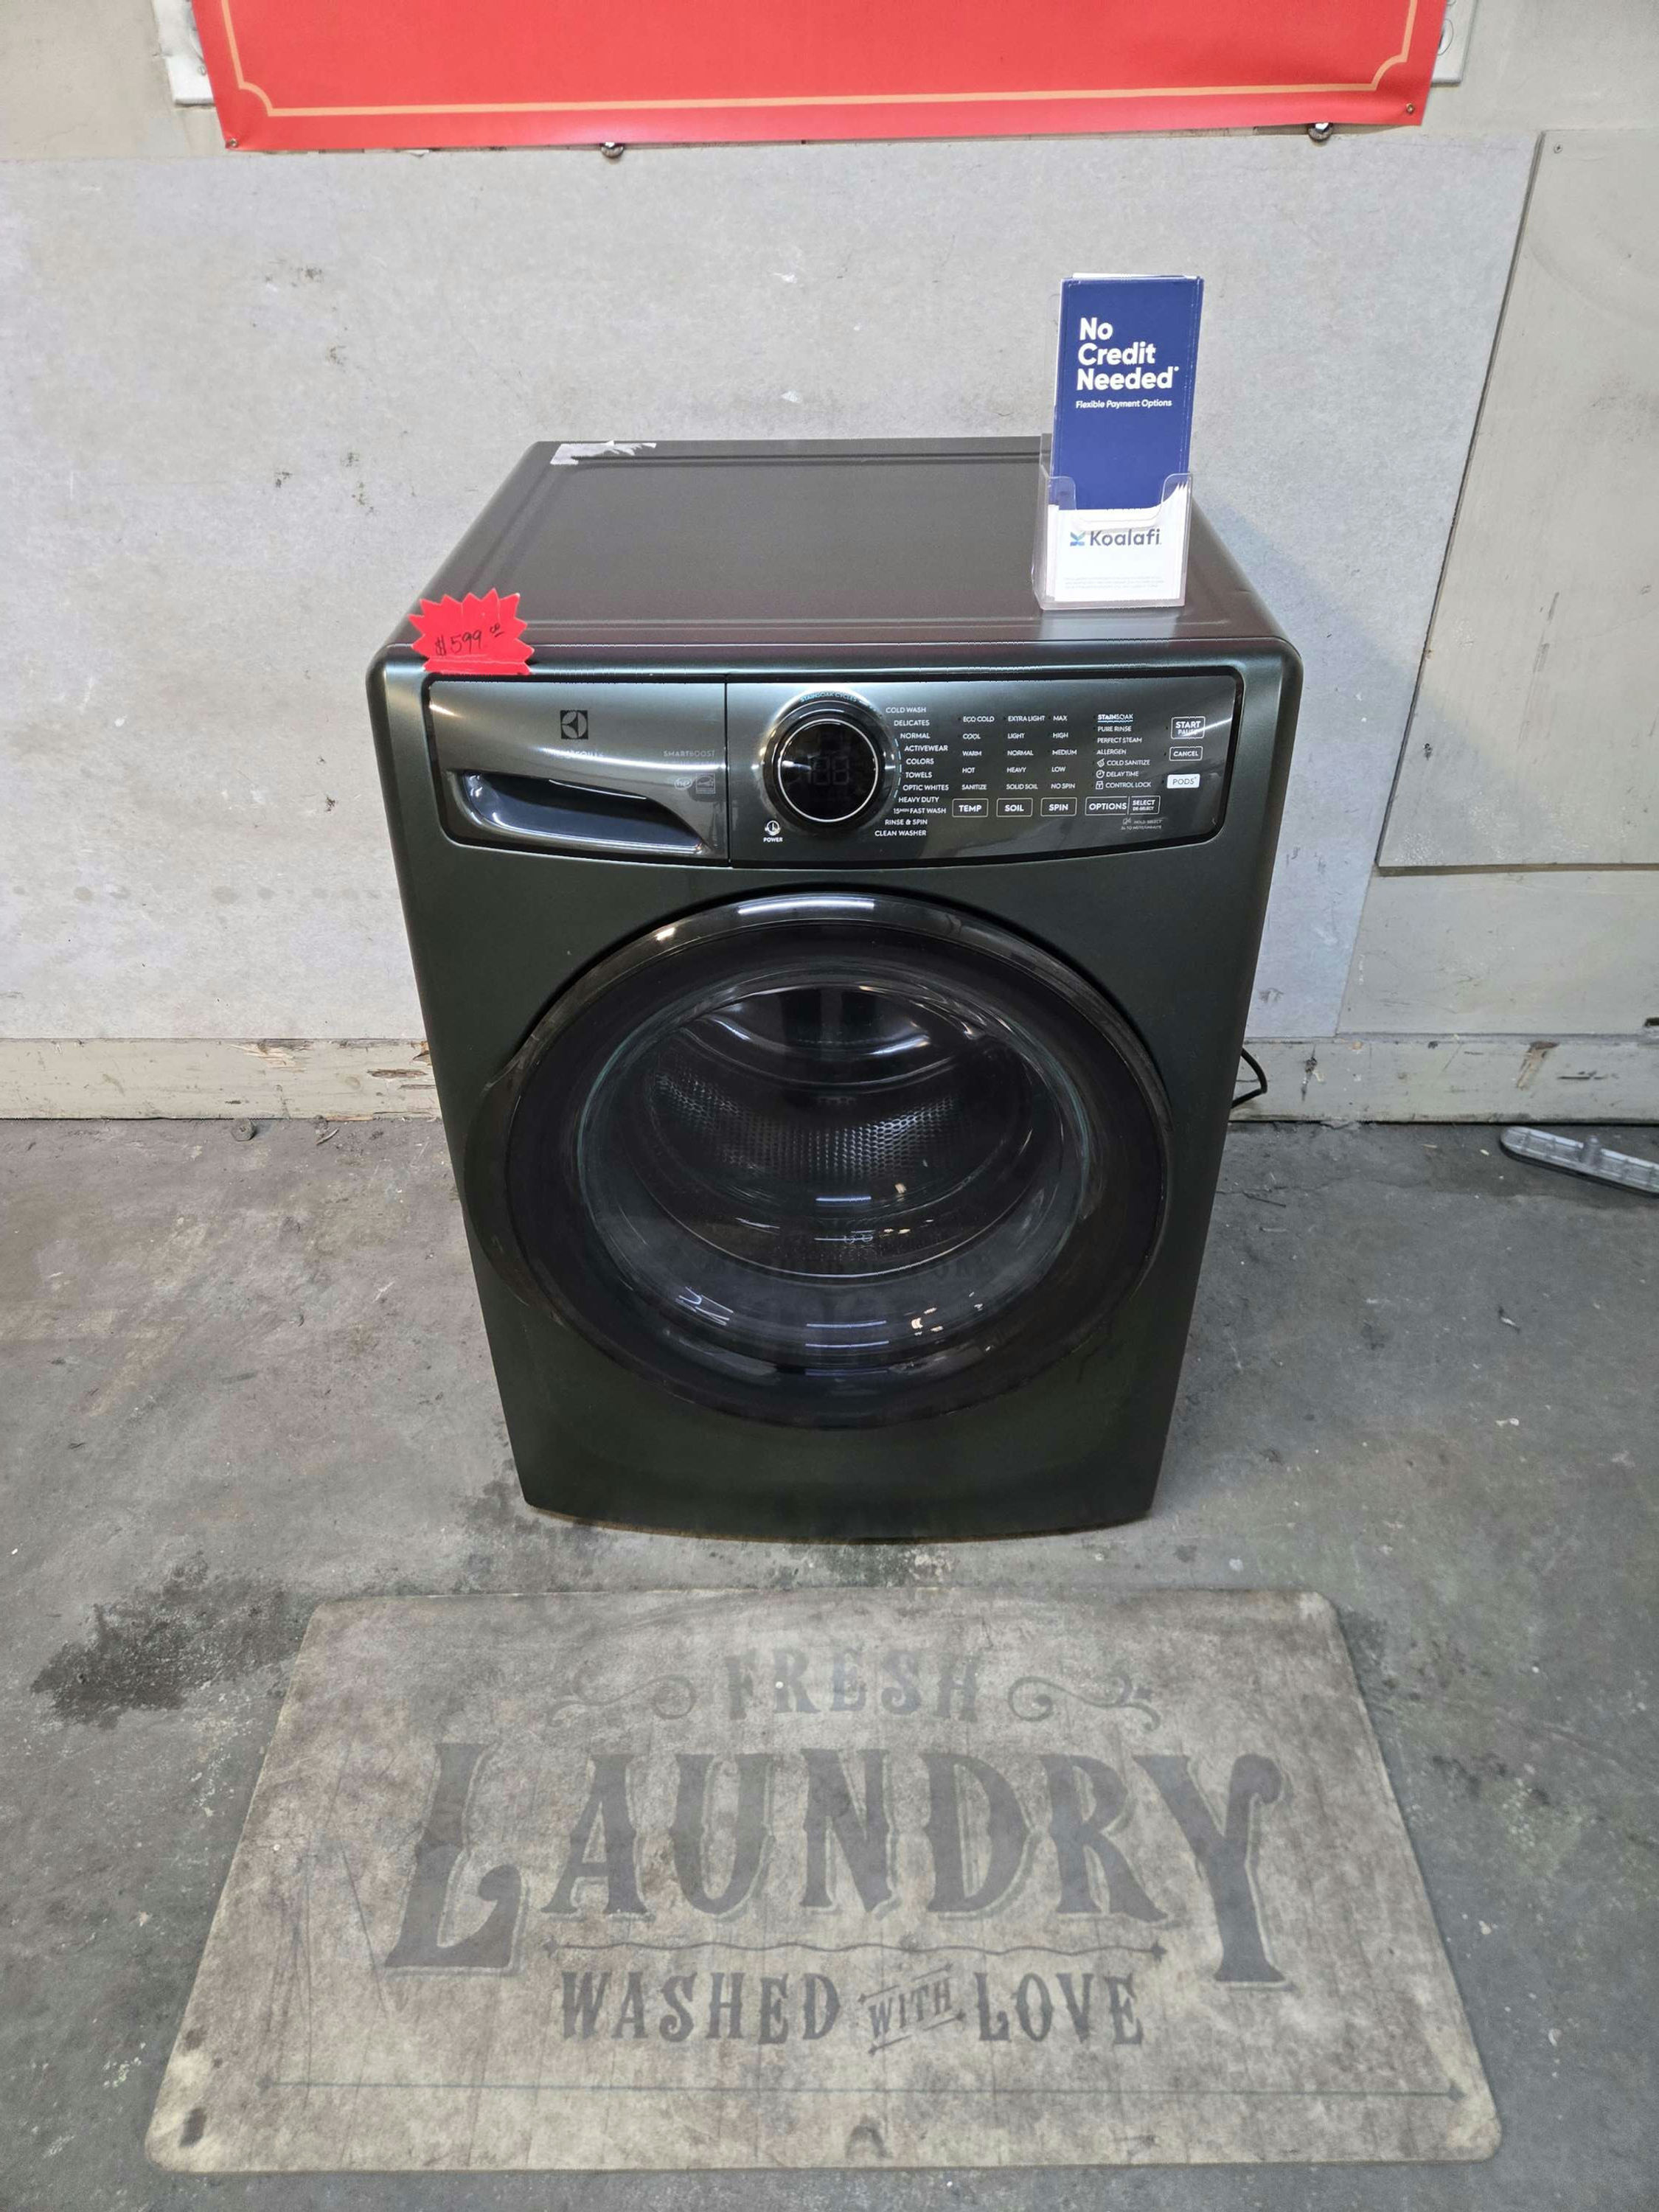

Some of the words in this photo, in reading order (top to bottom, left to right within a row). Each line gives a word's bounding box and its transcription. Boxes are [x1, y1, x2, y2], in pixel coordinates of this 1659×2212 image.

[1079, 317, 1113, 341] No
[1078, 341, 1156, 366] Credit
[1076, 400, 1105, 408] Flexible
[1107, 400, 1141, 410] Payment
[1142, 398, 1172, 408] Options
[1090, 528, 1161, 546] Koalafi
[959, 804, 982, 813] TEMP
[1089, 802, 1127, 810] OPTIONS
[723, 1647, 982, 1722] FRESH
[385, 1742, 1289, 1988] LAUNDRY
[560, 1970, 841, 2045] WASHED
[867, 1976, 953, 2039] WITH
[974, 1972, 1144, 2045] LOVE
